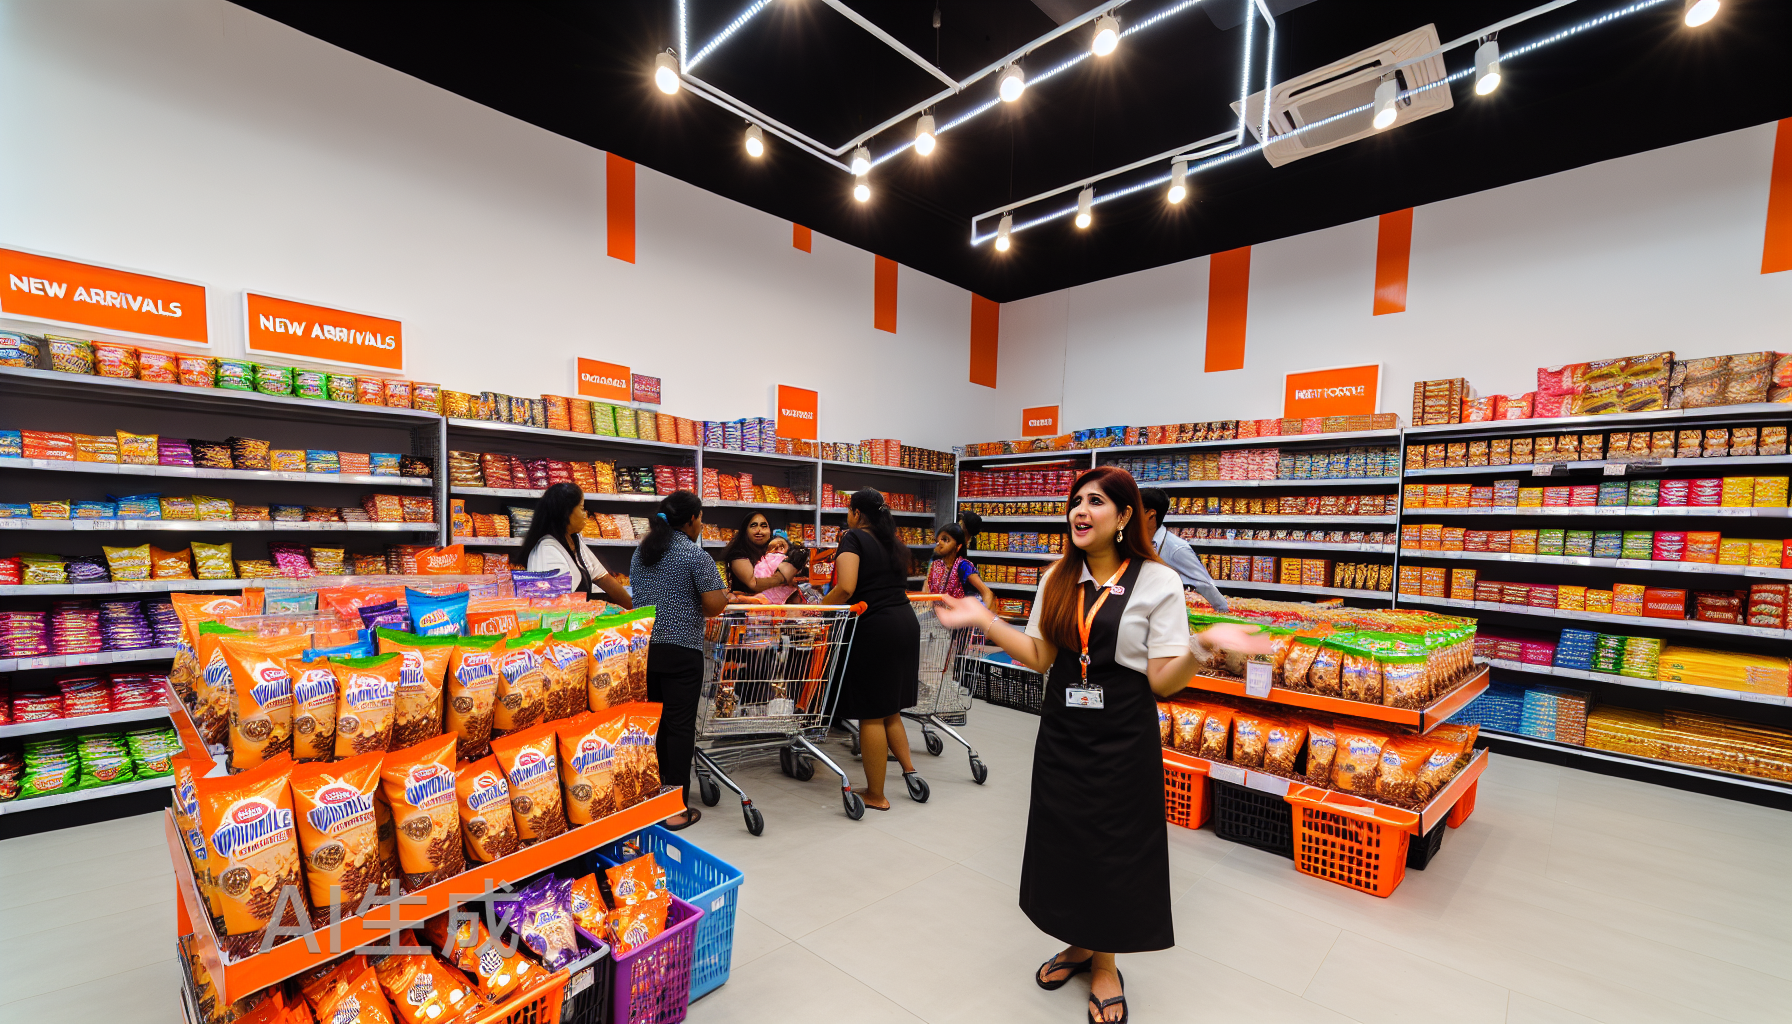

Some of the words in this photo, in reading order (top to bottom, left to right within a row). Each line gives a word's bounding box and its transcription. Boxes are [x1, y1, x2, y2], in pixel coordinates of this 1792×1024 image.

[9, 273, 67, 299] NEW
[73, 286, 183, 318] ARRIVALS
[259, 313, 307, 337] NEW
